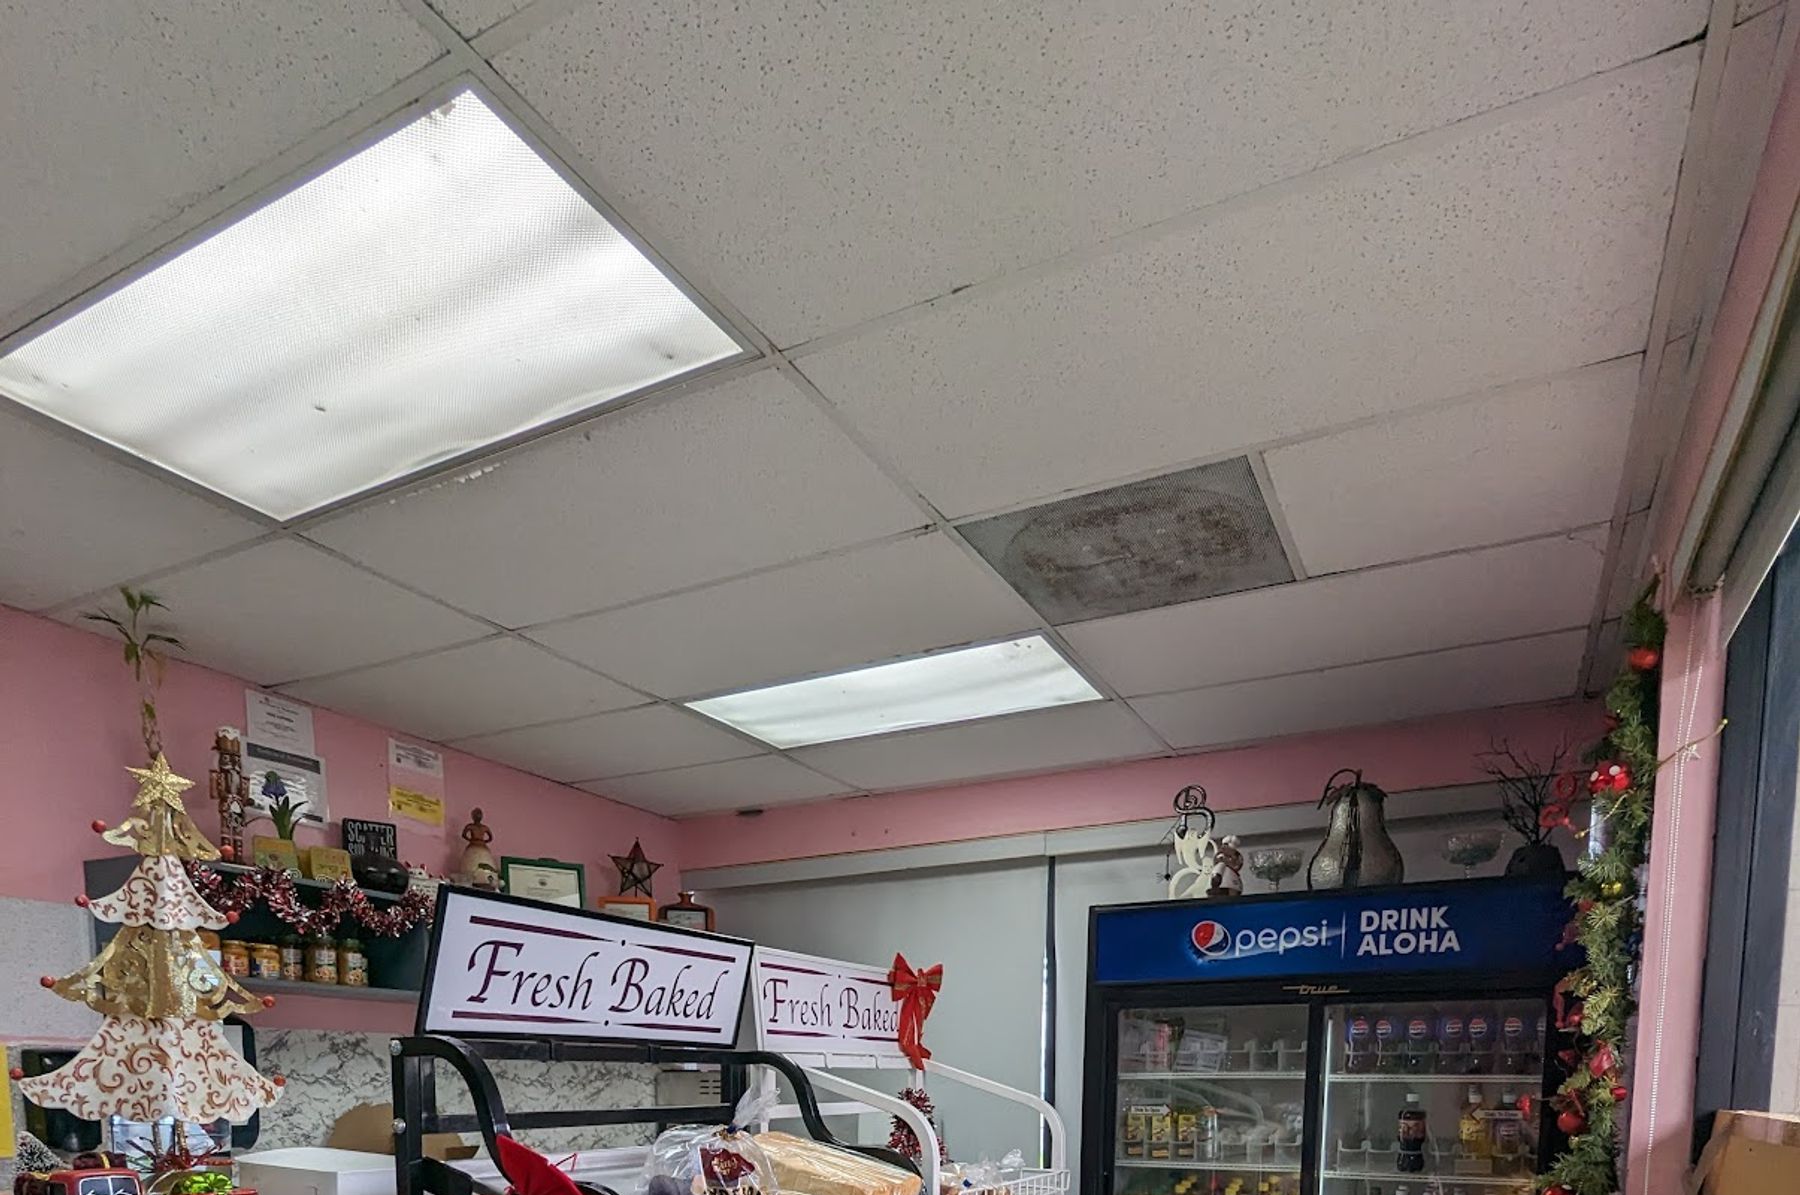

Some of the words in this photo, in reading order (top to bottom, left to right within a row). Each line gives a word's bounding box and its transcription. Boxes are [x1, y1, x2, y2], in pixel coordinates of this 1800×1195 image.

[1235, 919, 1329, 956] pepsi
[1360, 906, 1449, 932] DRINK
[1357, 930, 1461, 956] ALOHA
[466, 939, 600, 1010] Fresh
[608, 958, 729, 1020] Baked
[763, 978, 832, 1027] Fresh
